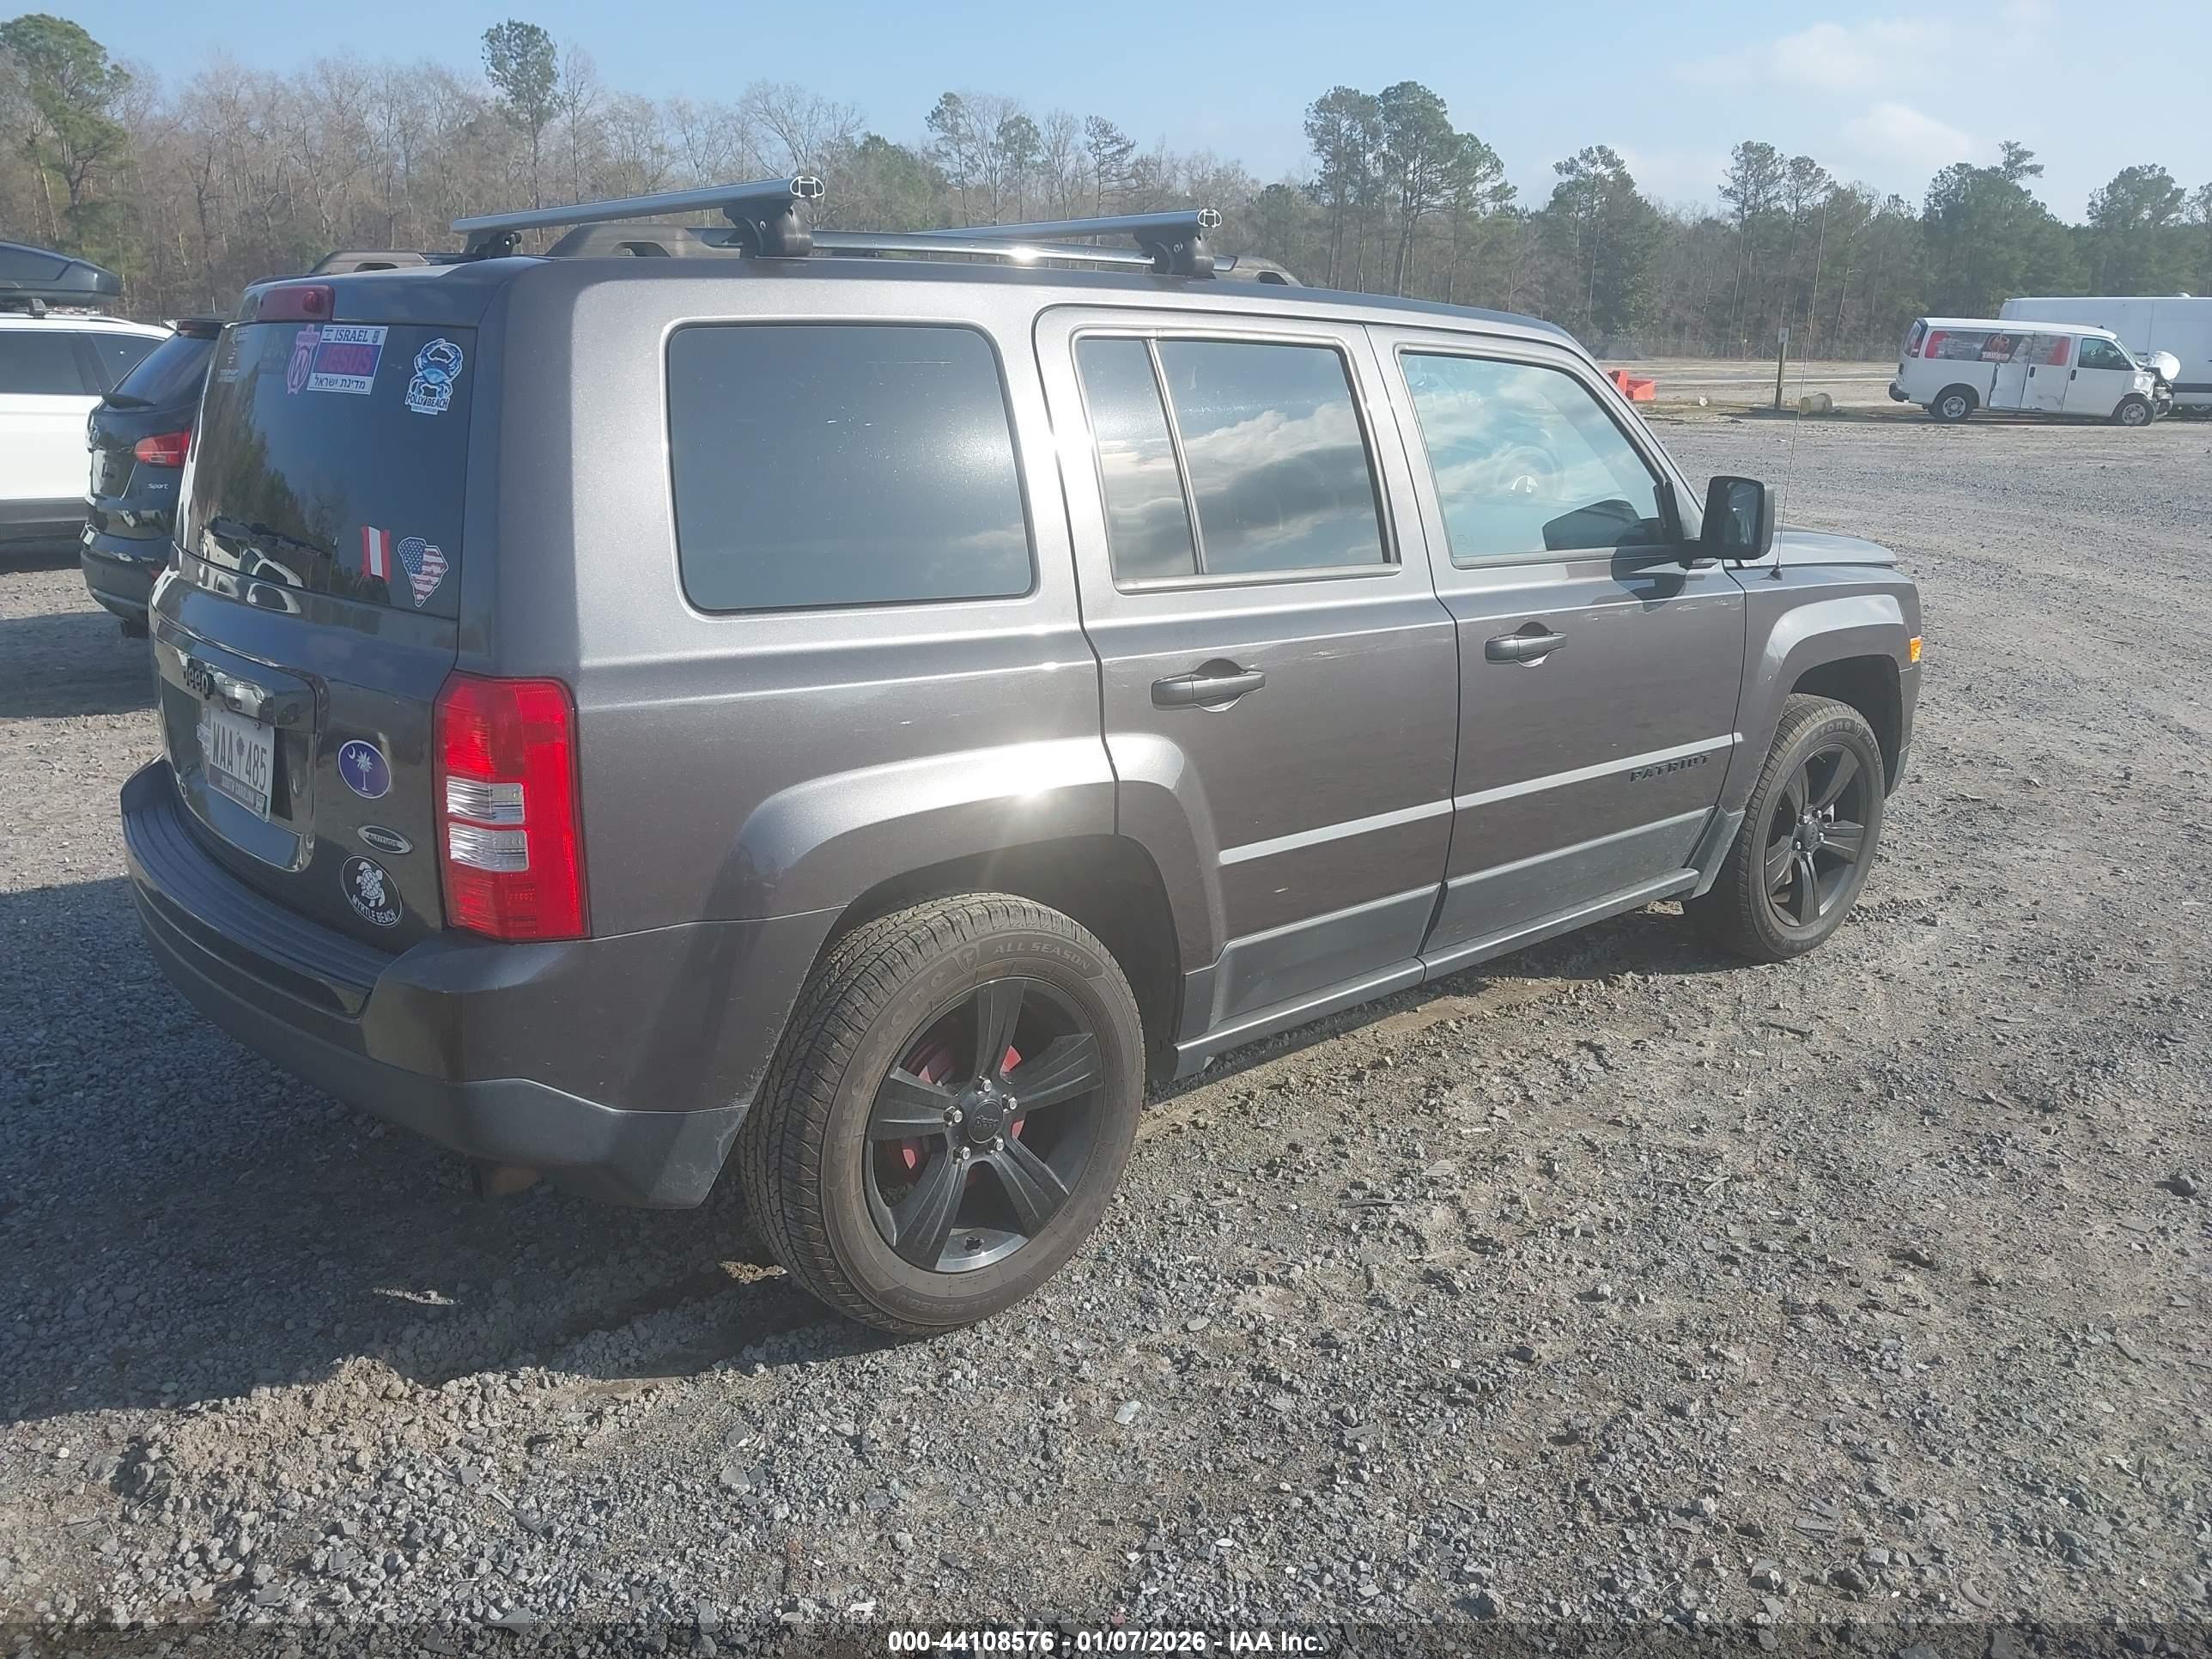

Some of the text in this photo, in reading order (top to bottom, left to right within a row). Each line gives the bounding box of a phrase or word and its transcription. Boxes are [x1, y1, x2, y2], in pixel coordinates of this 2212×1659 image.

[335, 329, 368, 343] ISRAEL
[319, 345, 373, 374] JESUS
[314, 374, 366, 390] מדינת ישראל
[407, 392, 427, 406] FOLLY
[426, 397, 447, 410] BEACH
[183, 661, 213, 700] Jeep
[212, 720, 268, 791] WAA 485
[1630, 753, 1711, 782] PATRIOT
[367, 831, 398, 847] ALTITUDE
[352, 894, 397, 923] MYRTLE BEACH
[995, 941, 1091, 970] ALL SEASON
